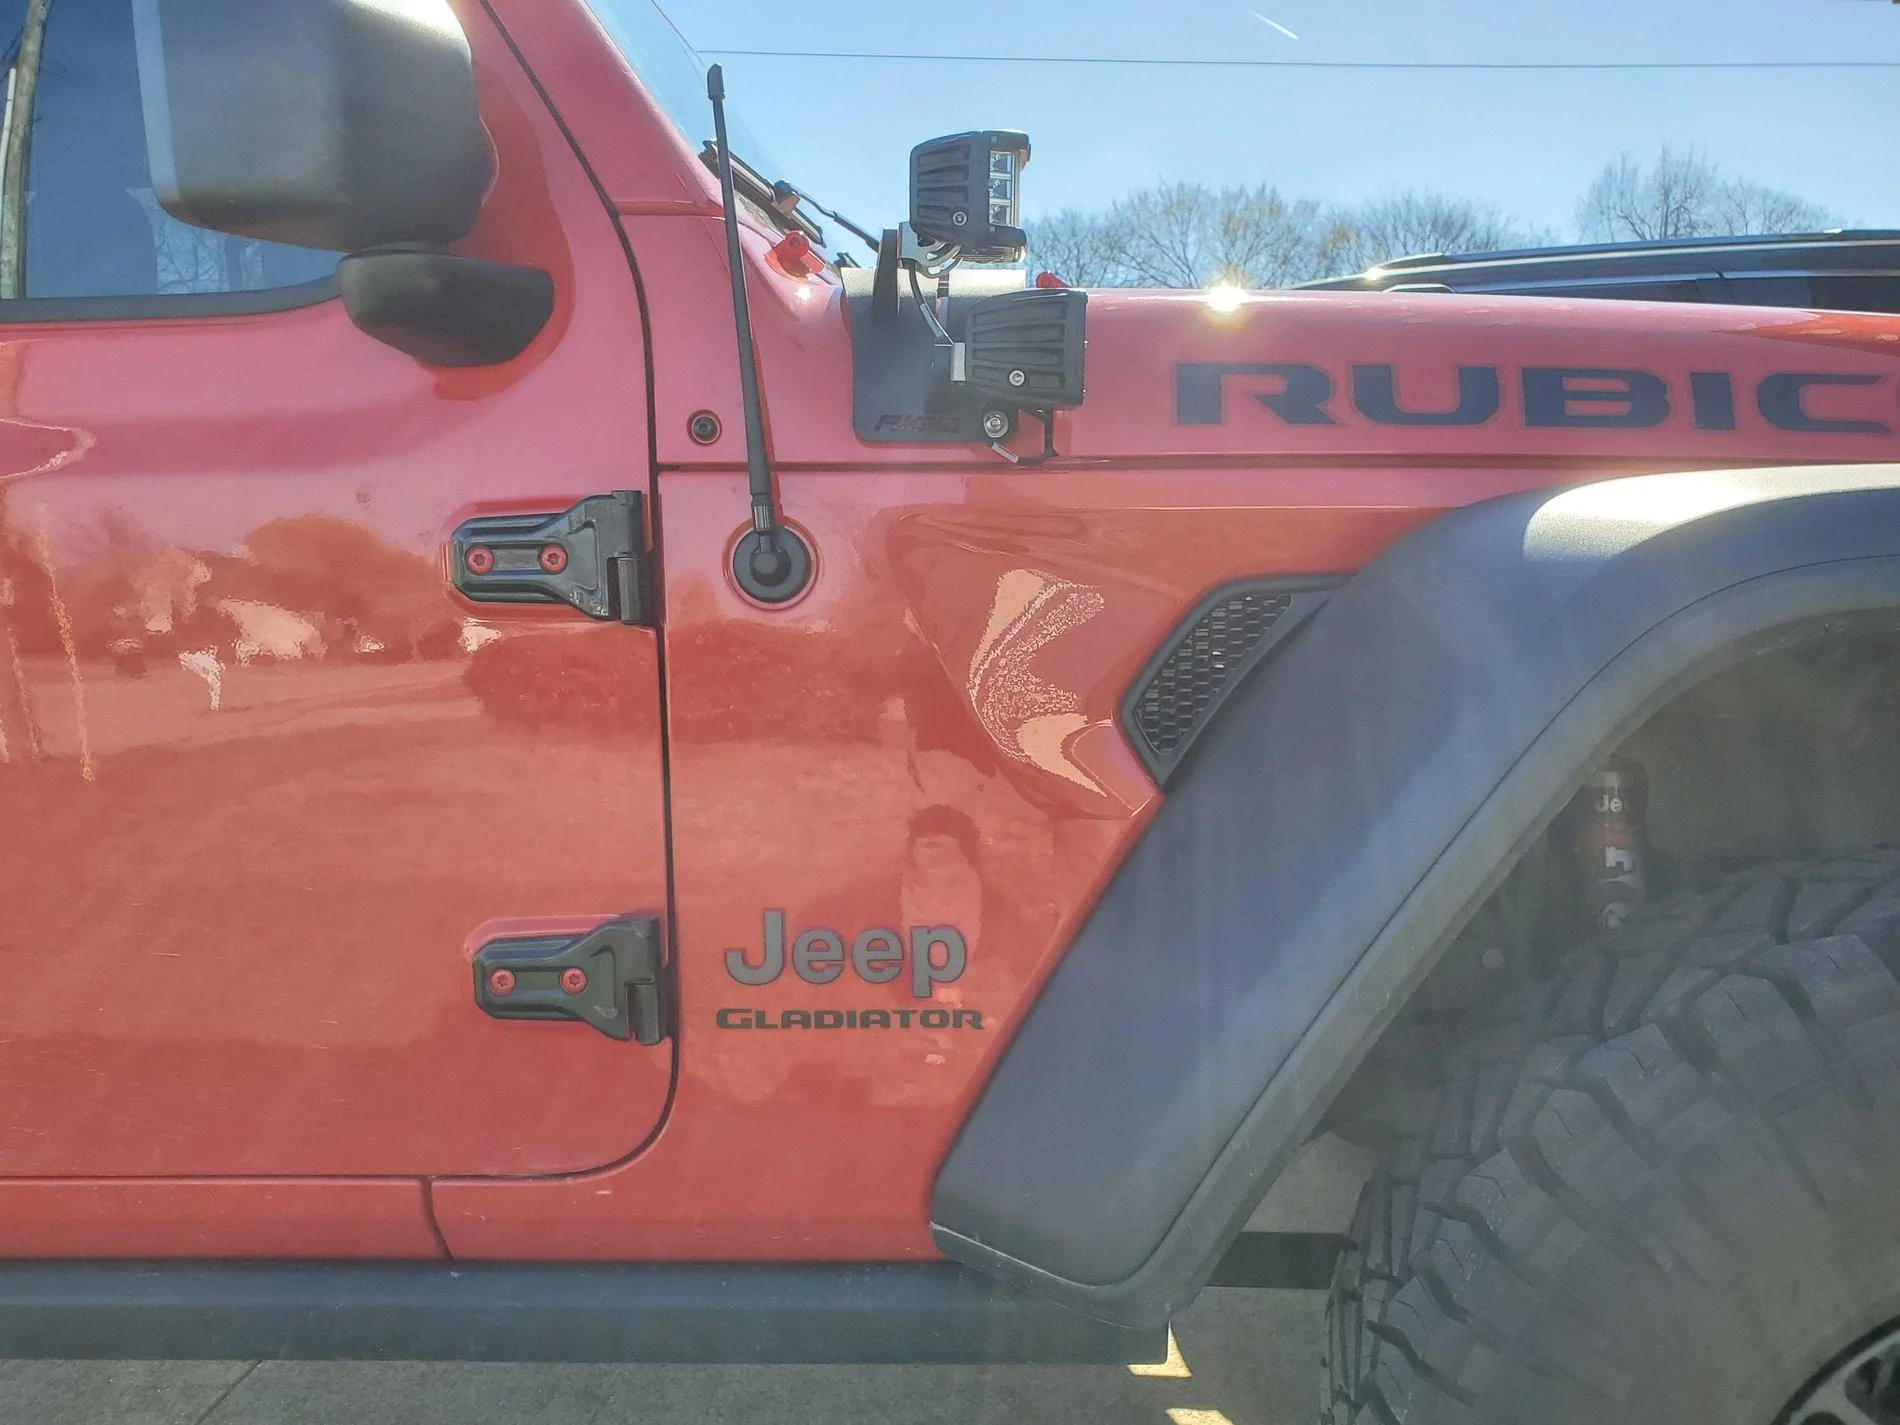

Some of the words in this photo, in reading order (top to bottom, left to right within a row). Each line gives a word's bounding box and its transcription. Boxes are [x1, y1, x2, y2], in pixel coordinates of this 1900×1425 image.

[1175, 362, 1895, 435] RUBIC
[724, 907, 967, 998] Jeep
[716, 1008, 984, 1030] GLADIATOR
